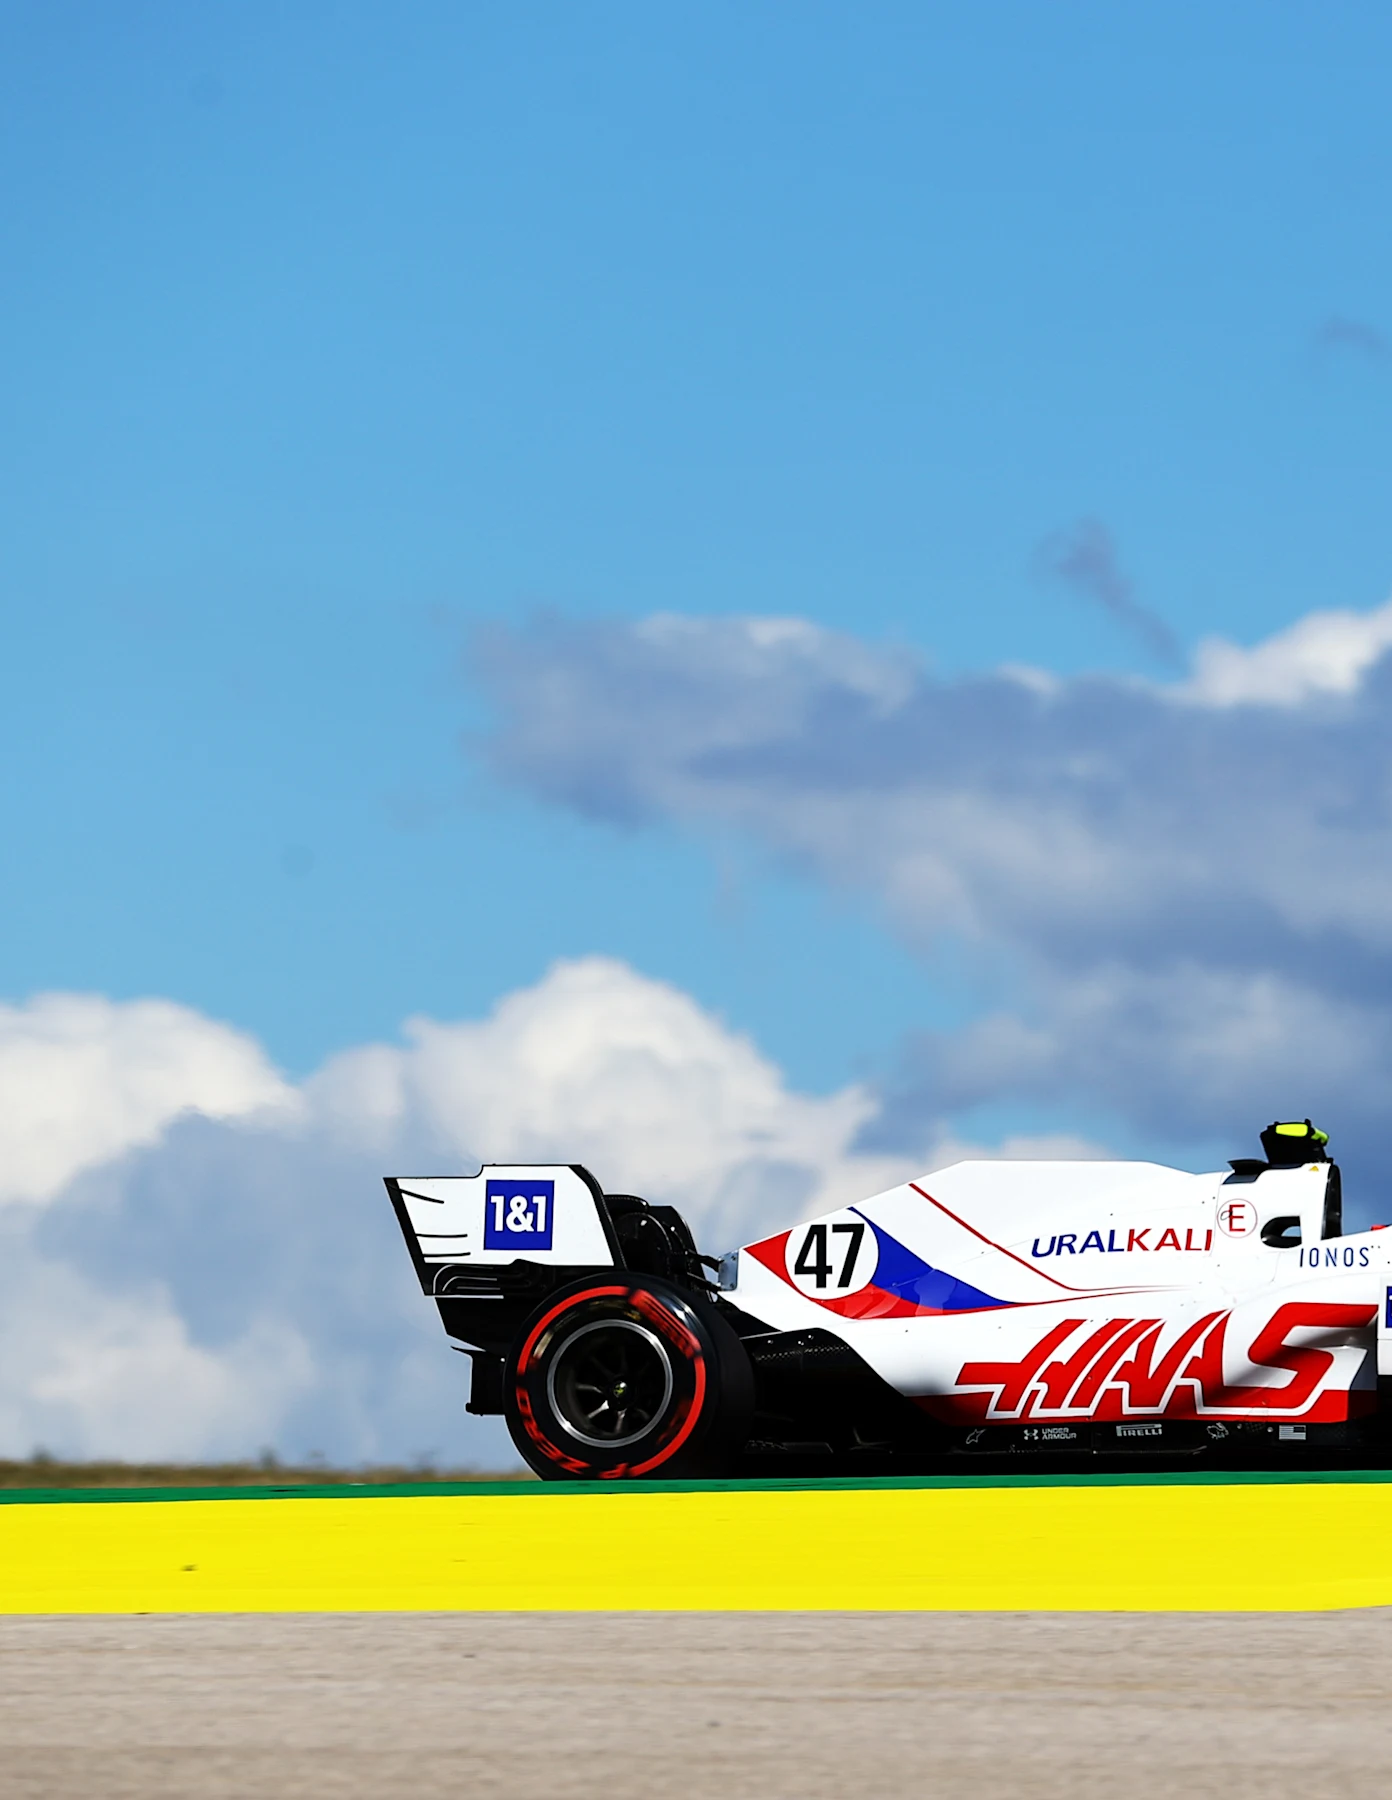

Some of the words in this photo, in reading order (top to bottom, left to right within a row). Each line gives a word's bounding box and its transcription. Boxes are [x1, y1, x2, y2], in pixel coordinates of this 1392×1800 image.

[491, 1195, 547, 1233] 1&1
[1229, 1204, 1246, 1232] E
[794, 1223, 866, 1290] 47
[1031, 1228, 1213, 1258] URALKALI
[1300, 1247, 1370, 1268] IONOS
[954, 1302, 1379, 1420] HAAS
[1116, 1423, 1163, 1437] PIRELLI
